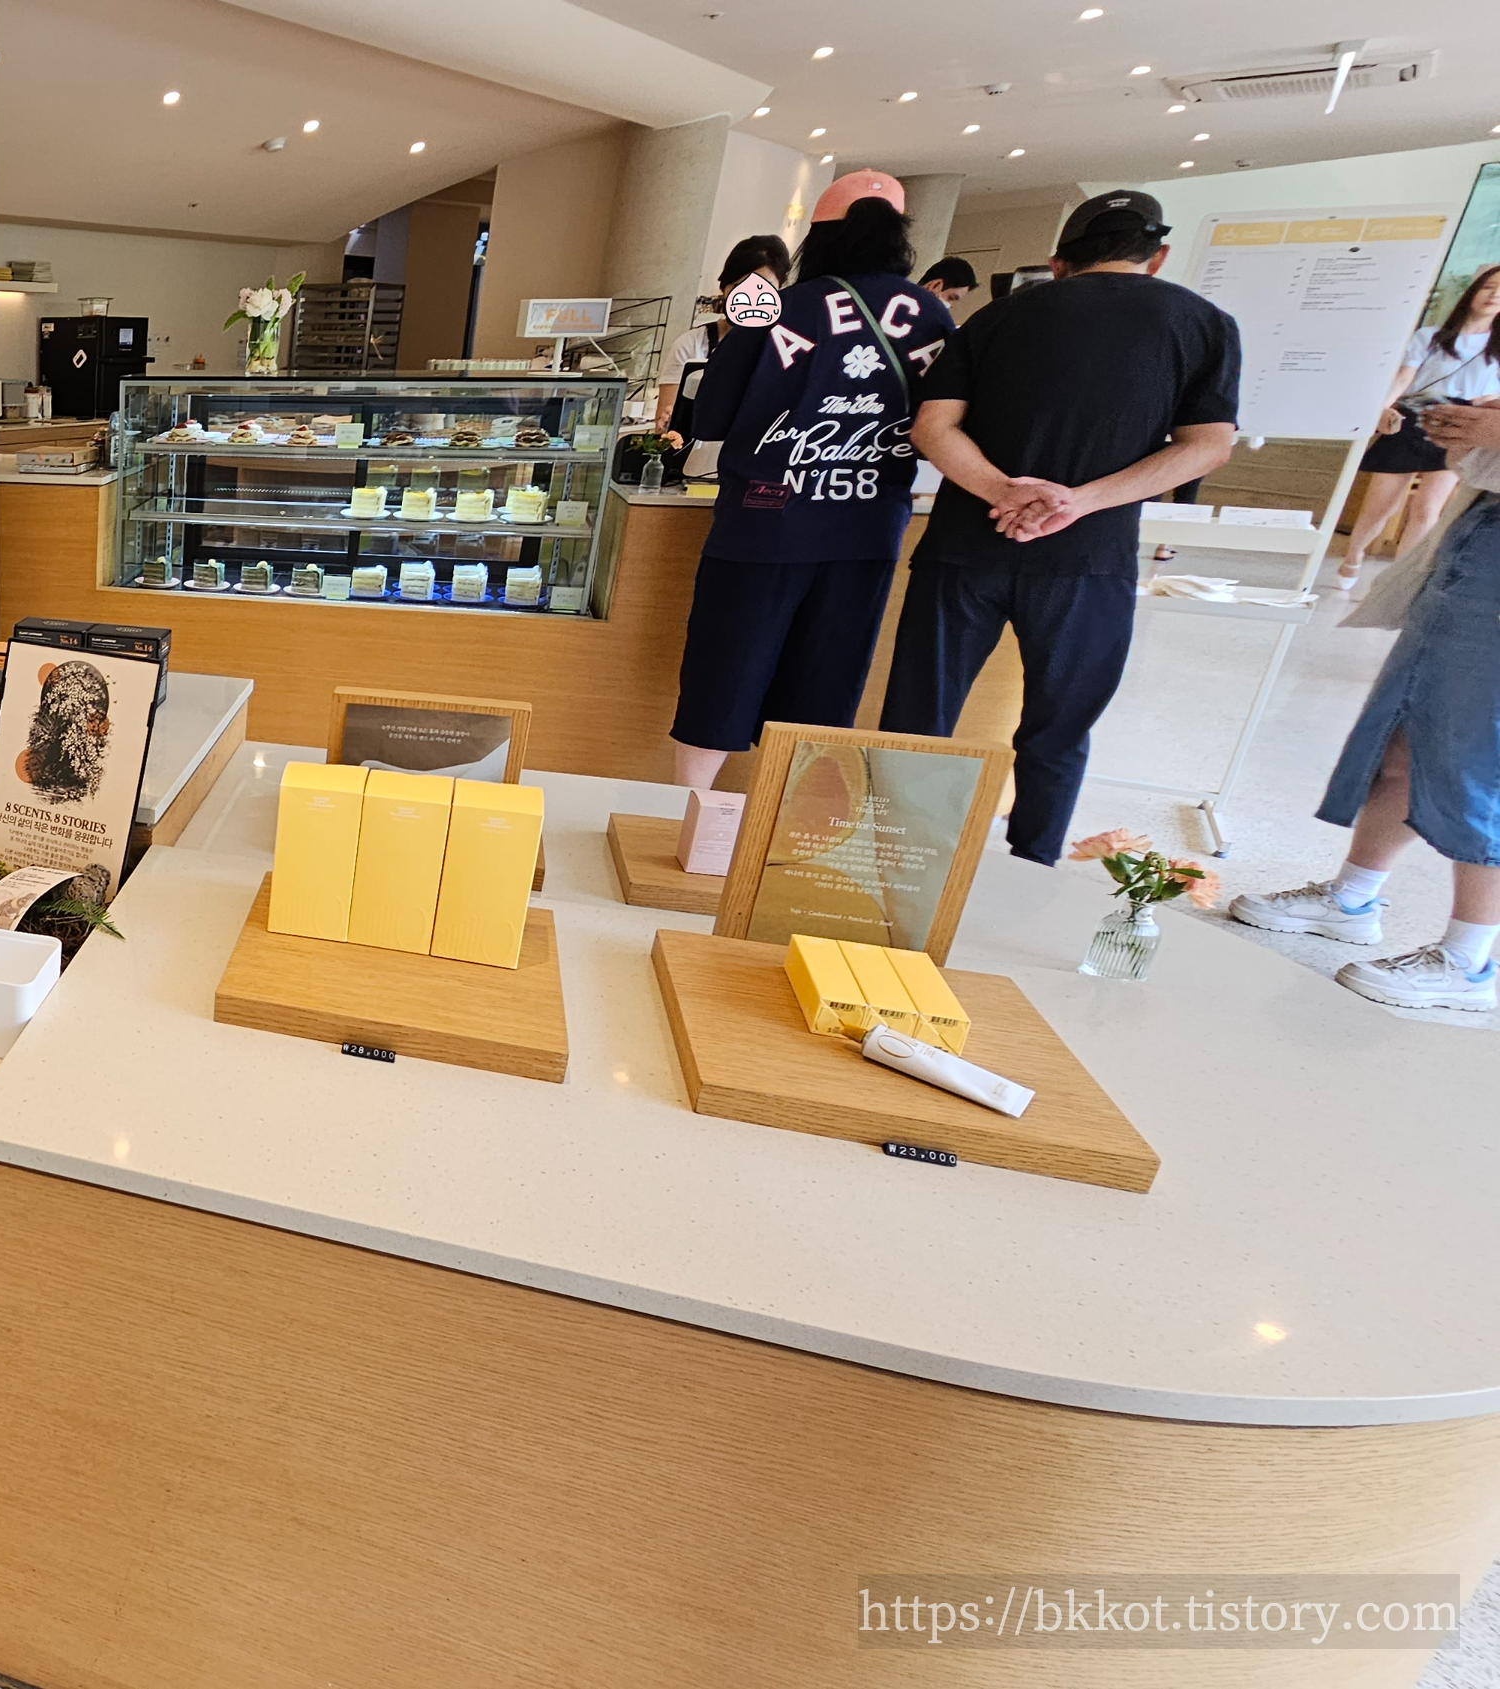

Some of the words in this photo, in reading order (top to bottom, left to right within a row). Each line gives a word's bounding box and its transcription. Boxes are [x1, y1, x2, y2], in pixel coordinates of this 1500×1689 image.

[818, 395, 850, 414] The
[754, 410, 807, 455] for
[5, 802, 11, 812] 8
[54, 813, 60, 823] 8
[62, 815, 106, 834] STORIES
[18, 818, 33, 829] 삶의
[34, 821, 49, 833] 작은
[50, 825, 73, 839] 변화를
[74, 831, 113, 849] 응원합니다
[828, 816, 855, 828] Time
[856, 821, 871, 831] for
[871, 823, 906, 835] Sunset
